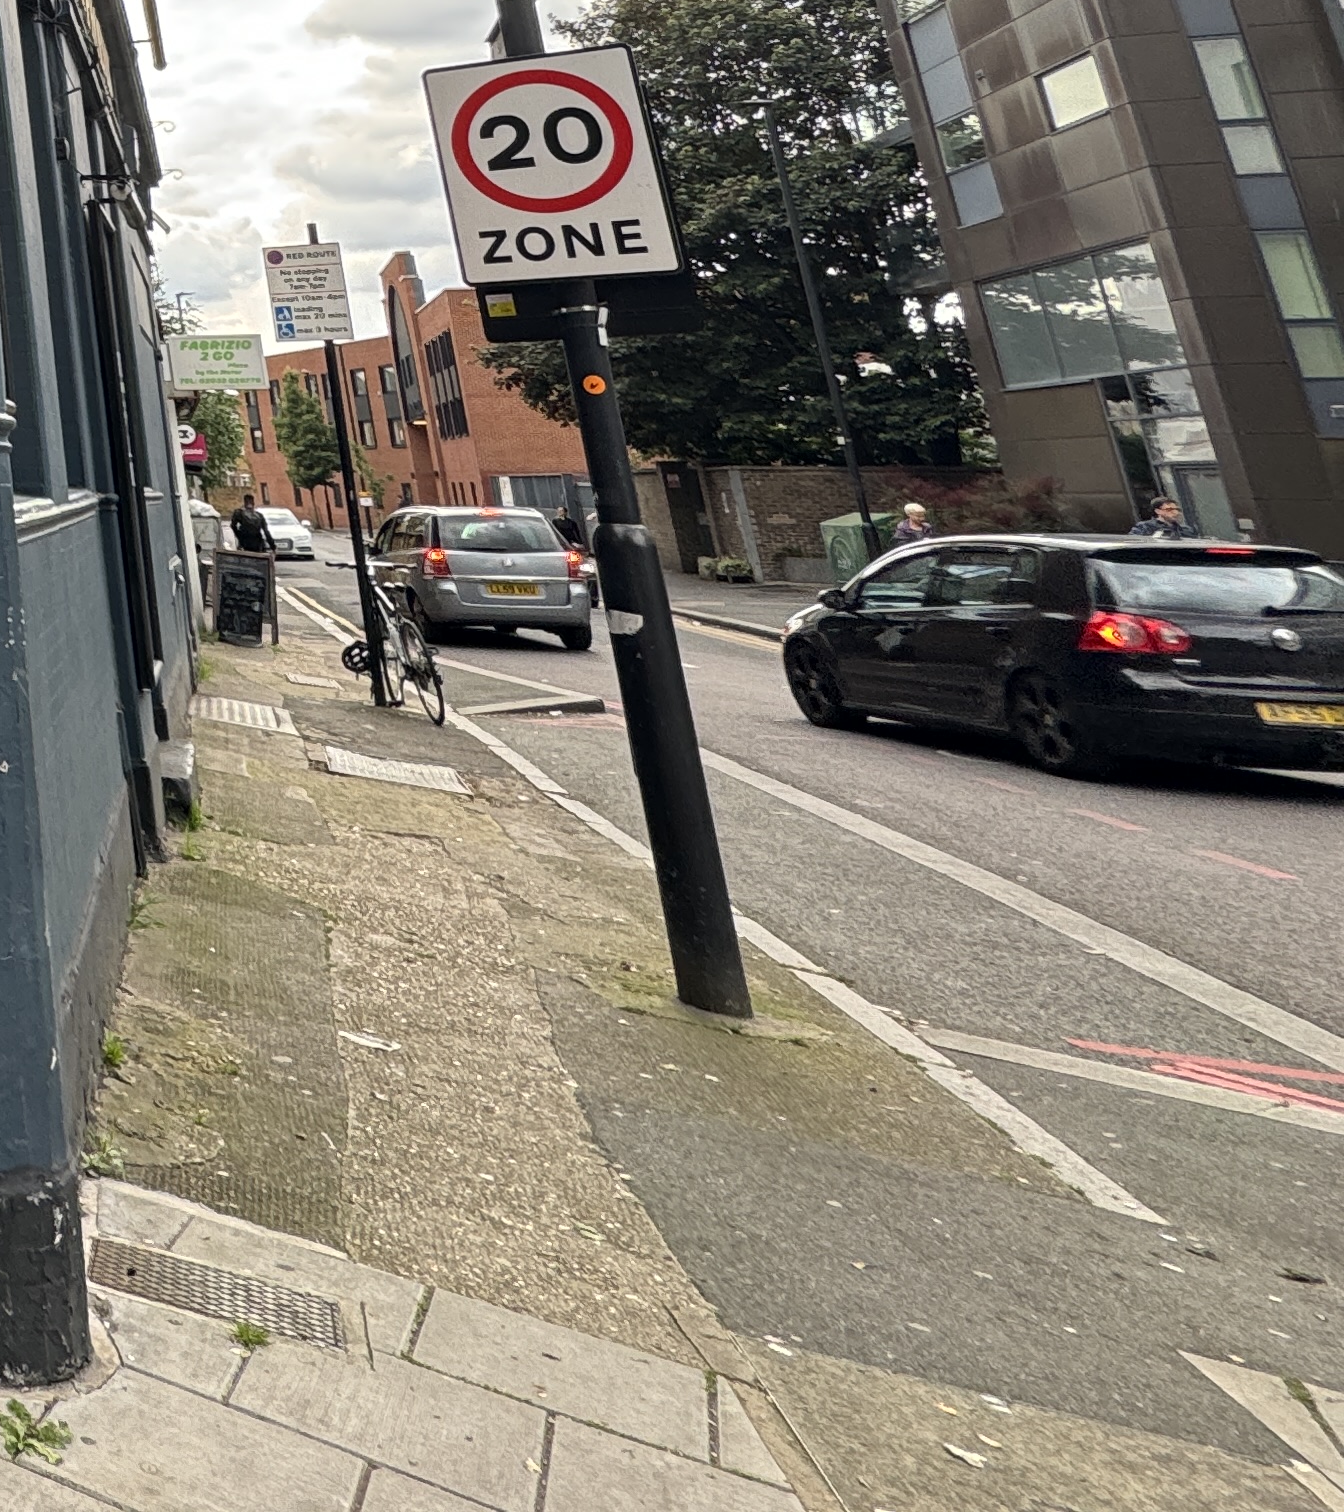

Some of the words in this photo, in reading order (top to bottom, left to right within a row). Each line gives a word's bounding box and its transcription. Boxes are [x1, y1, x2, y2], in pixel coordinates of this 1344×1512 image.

[479, 106, 603, 171] 20
[478, 218, 649, 265] ZONE
[286, 252, 305, 260] RED
[306, 250, 337, 259] ROUTE
[179, 339, 252, 351] FABRIZIO
[199, 352, 210, 361] 2
[211, 351, 235, 361] GO
